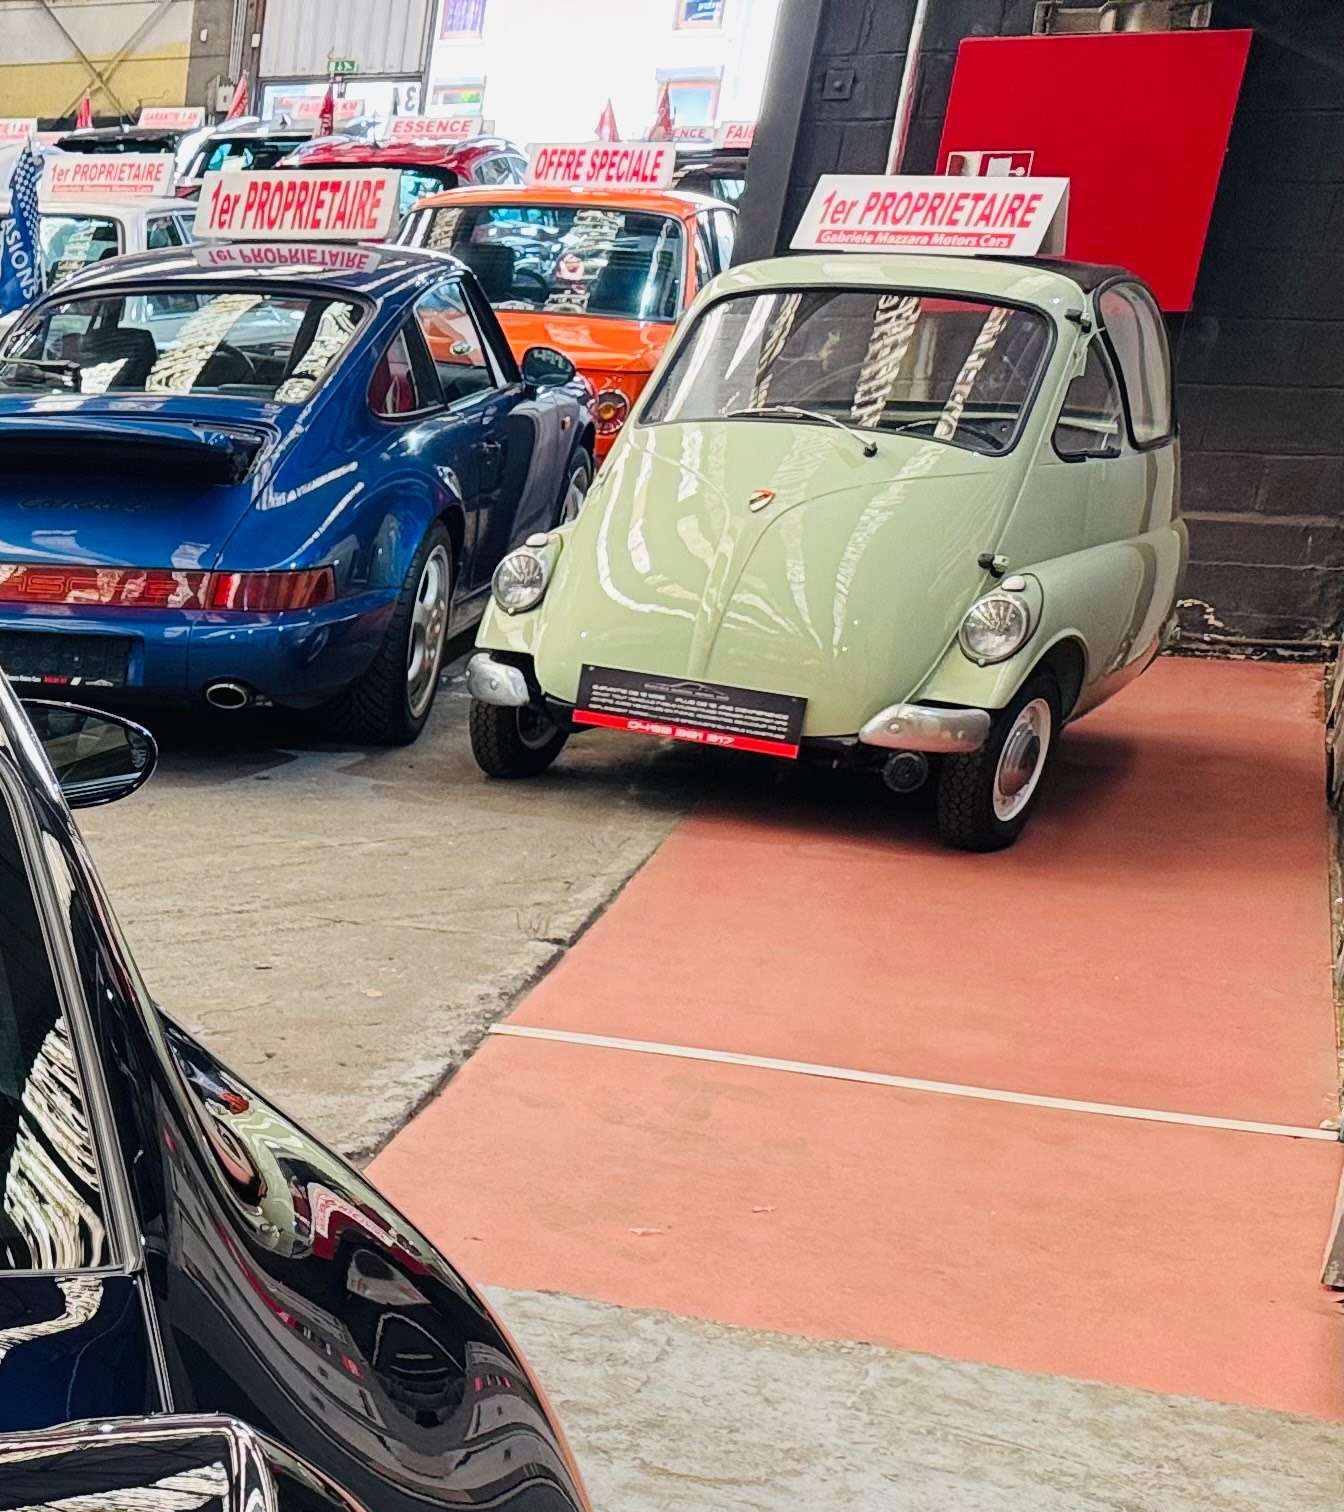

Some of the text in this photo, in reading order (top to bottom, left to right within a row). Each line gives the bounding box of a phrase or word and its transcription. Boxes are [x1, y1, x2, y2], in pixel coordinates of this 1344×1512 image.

[392, 119, 473, 133] ESSENCE
[72, 162, 165, 181] PROPRIETAIRE
[534, 149, 664, 183] OFFRE SPECIALE
[209, 178, 386, 229] 1er PROPRIETAIRE
[819, 190, 1044, 229] 1er PROPRIETAIRE
[820, 230, 874, 244] Gabriele
[979, 234, 1009, 248] Cars
